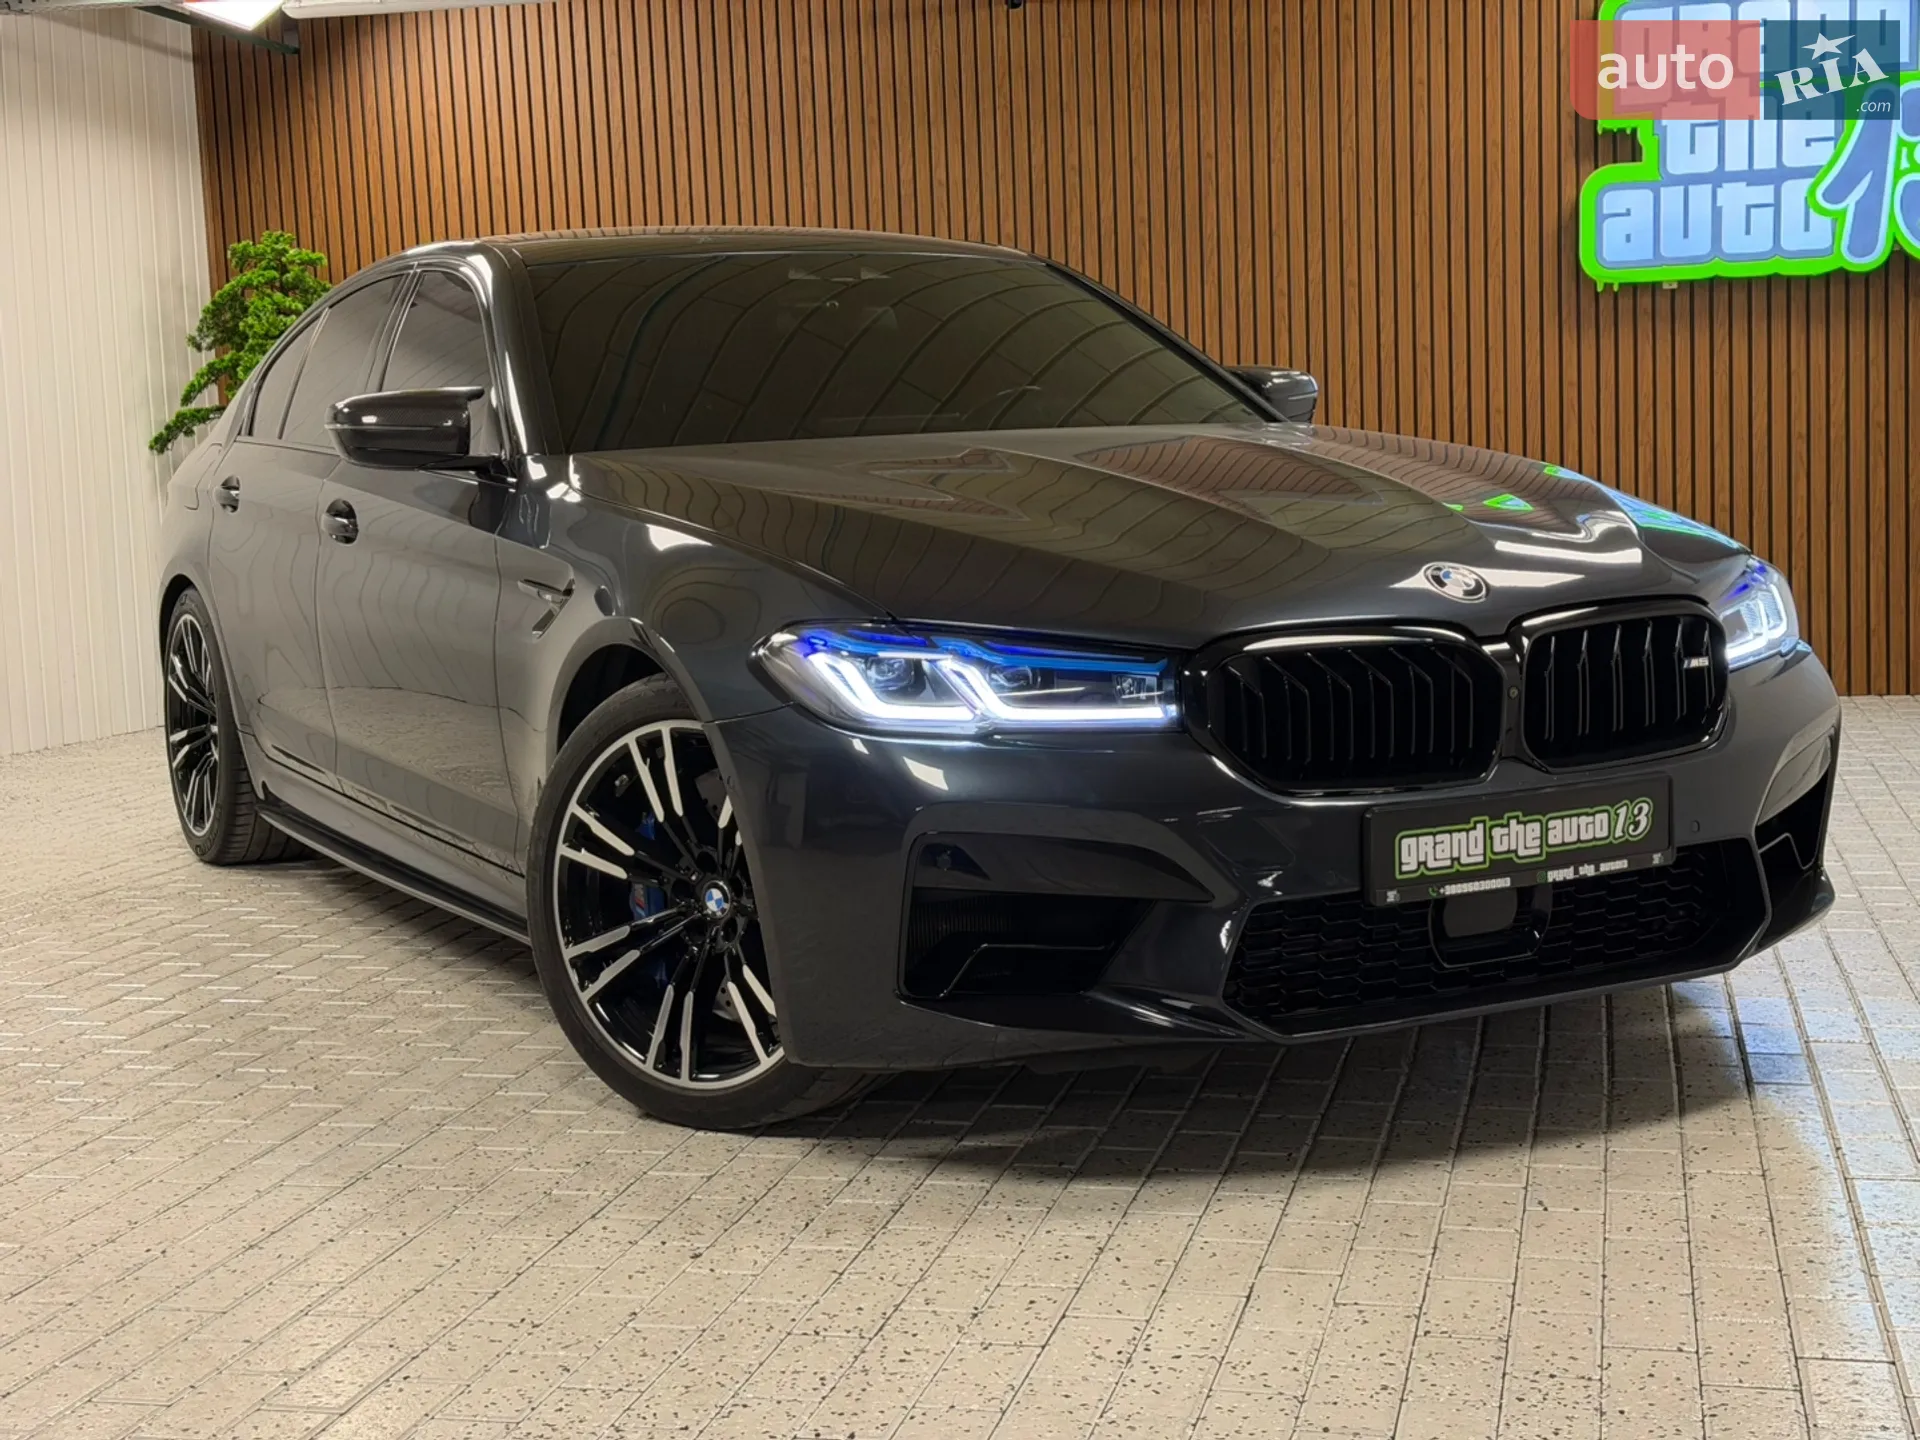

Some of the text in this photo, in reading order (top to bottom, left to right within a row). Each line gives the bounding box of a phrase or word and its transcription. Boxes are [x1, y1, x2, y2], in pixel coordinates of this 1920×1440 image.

[1602, 177, 1833, 262] auto
[1491, 818, 1541, 857] the
[1547, 812, 1610, 845] auto
[1614, 802, 1650, 839] 13
